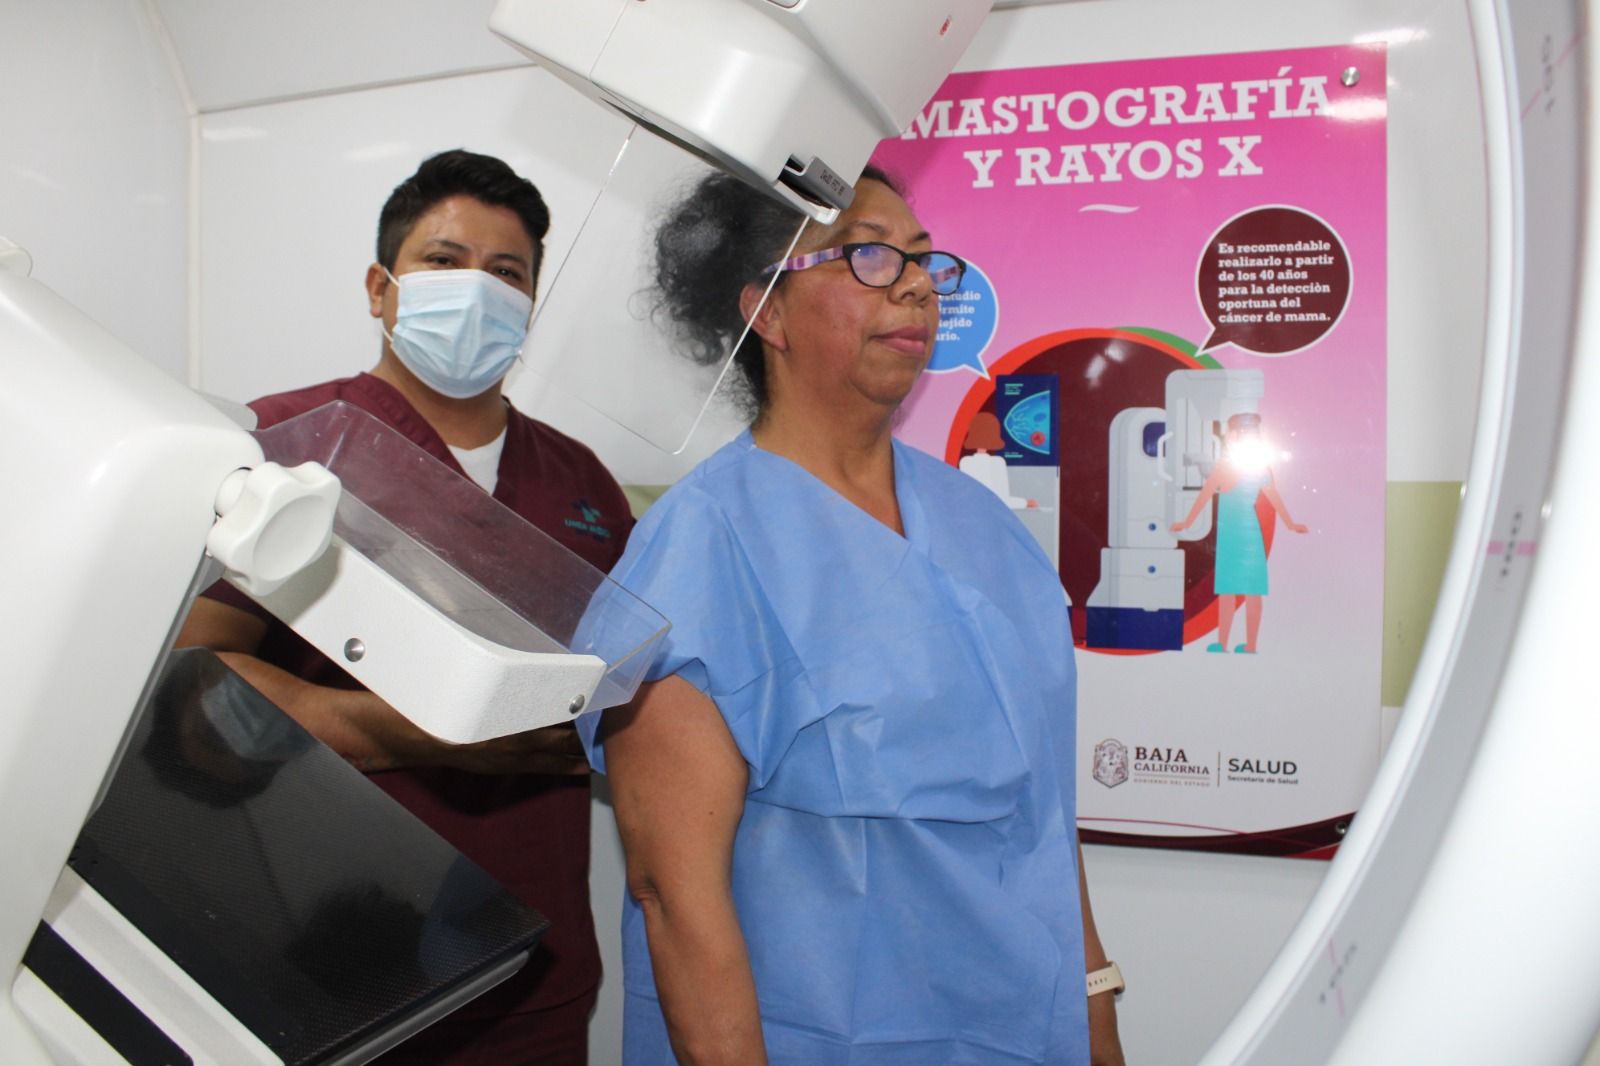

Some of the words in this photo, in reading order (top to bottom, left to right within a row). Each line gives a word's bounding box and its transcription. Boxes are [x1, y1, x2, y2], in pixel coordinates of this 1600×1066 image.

[900, 66, 1329, 140] MASTOGRAFÍA
[963, 150, 1003, 189] Y
[1015, 139, 1204, 187] RAYOS
[1218, 135, 1264, 177] X
[1218, 243, 1234, 254] Es
[1237, 240, 1331, 253] recomendable
[1218, 256, 1282, 267] realizarlo
[1284, 257, 1293, 266] a
[1295, 254, 1334, 267] partir
[1218, 270, 1234, 282] de
[1237, 270, 1256, 281] los
[1259, 270, 1274, 280] 40
[1277, 269, 1308, 280] años
[1218, 285, 1248, 298] para
[1251, 284, 1263, 295] la
[938, 304, 975, 314] rmite
[1218, 299, 1277, 311] oportuna
[1279, 297, 1301, 308] del
[1218, 311, 1263, 323] cáncer
[1265, 311, 1282, 322] de
[1284, 313, 1331, 322] mama.
[936, 331, 960, 341] ario.
[1135, 746, 1188, 763] BAJA
[1134, 763, 1210, 775] CALIFORNIA
[1228, 758, 1298, 776] SALUD
[1266, 776, 1276, 784] de
[1277, 777, 1298, 785] Salud
